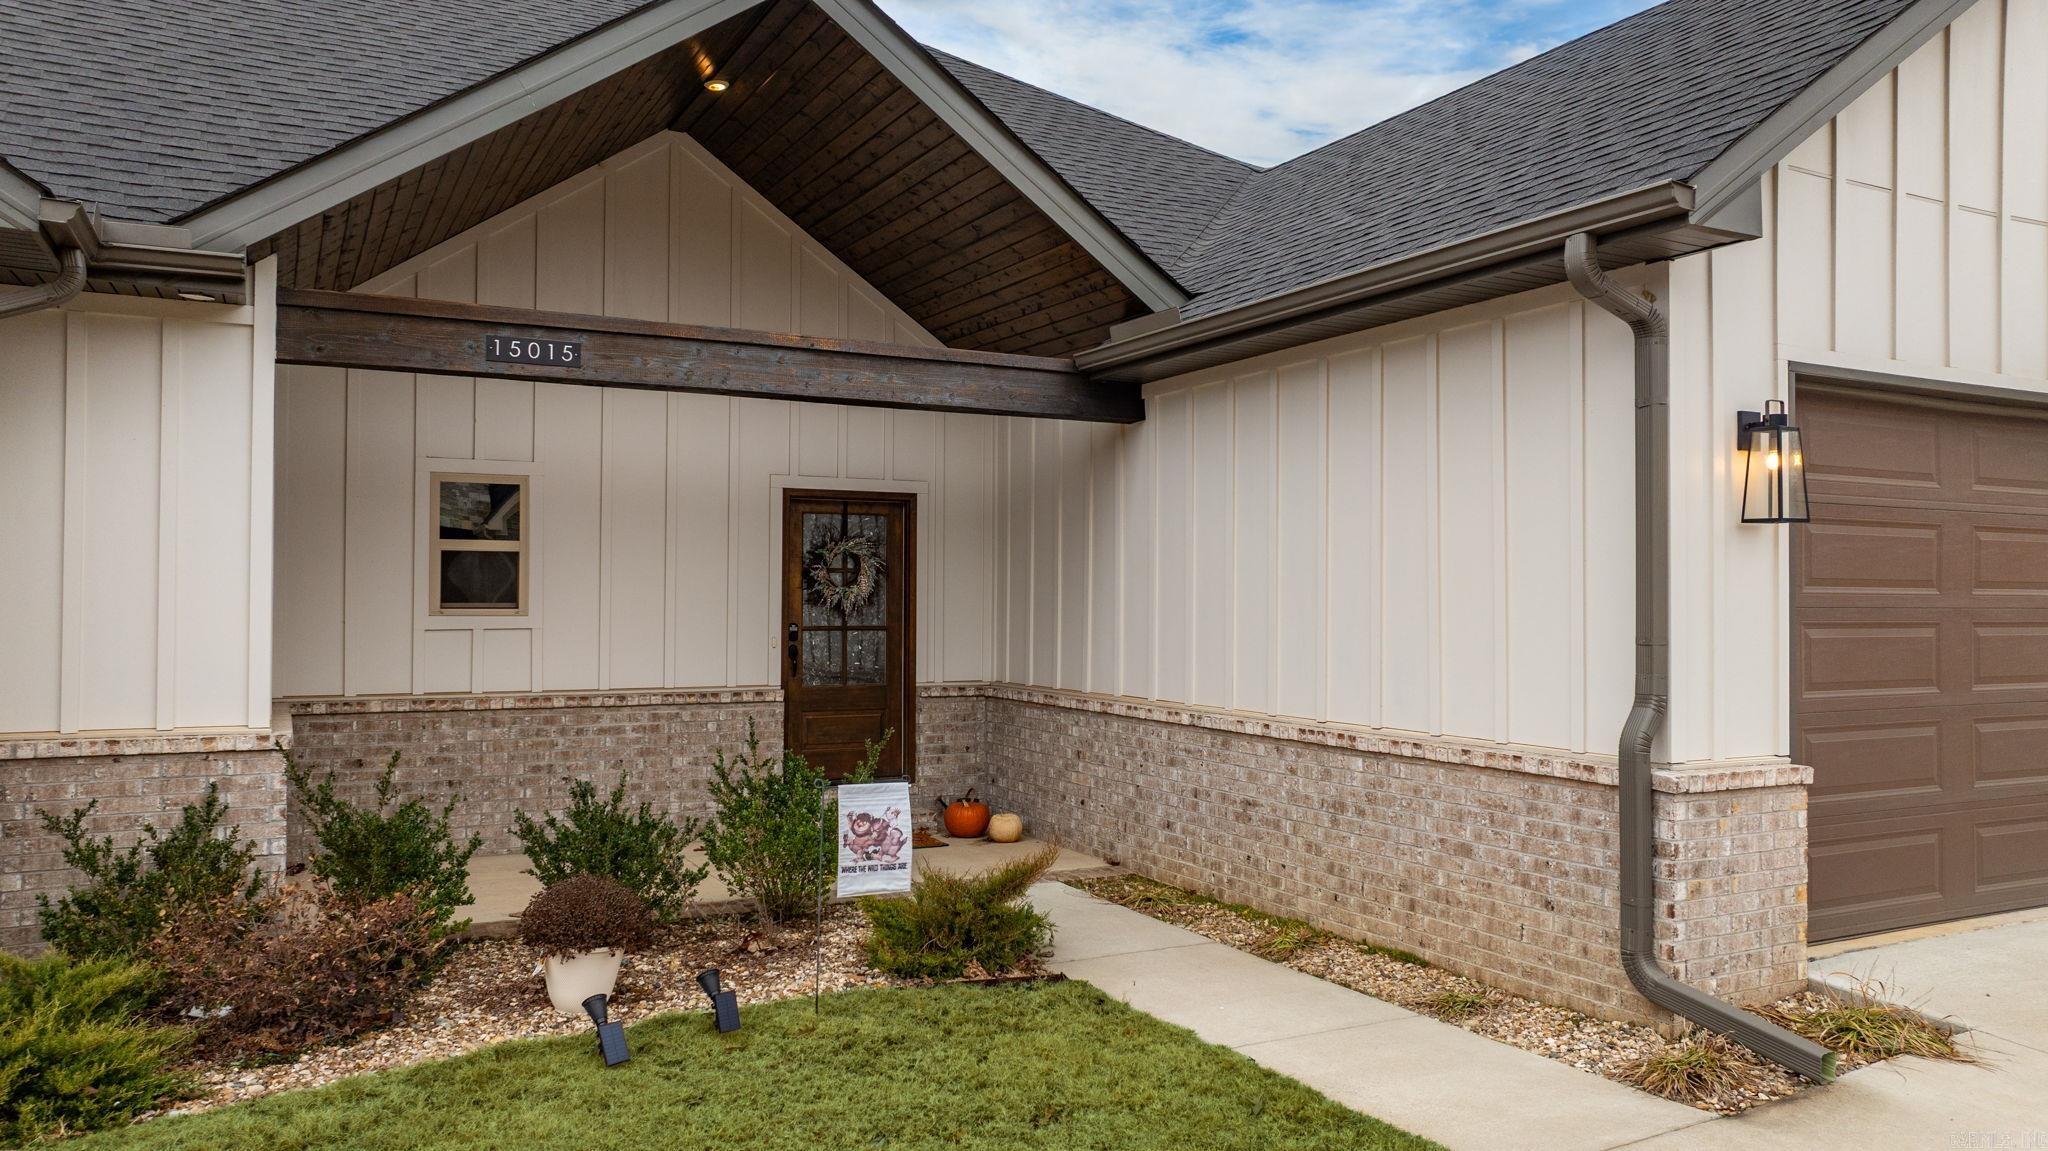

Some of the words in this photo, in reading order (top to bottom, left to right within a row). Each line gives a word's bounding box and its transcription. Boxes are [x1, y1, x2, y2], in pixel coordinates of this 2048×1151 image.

[494, 339, 573, 362] 15015
[841, 865, 858, 874] WHERE
[858, 865, 867, 873] THE
[867, 864, 879, 872] WILD
[880, 863, 897, 871] THINGS
[897, 862, 908, 870] ARE
